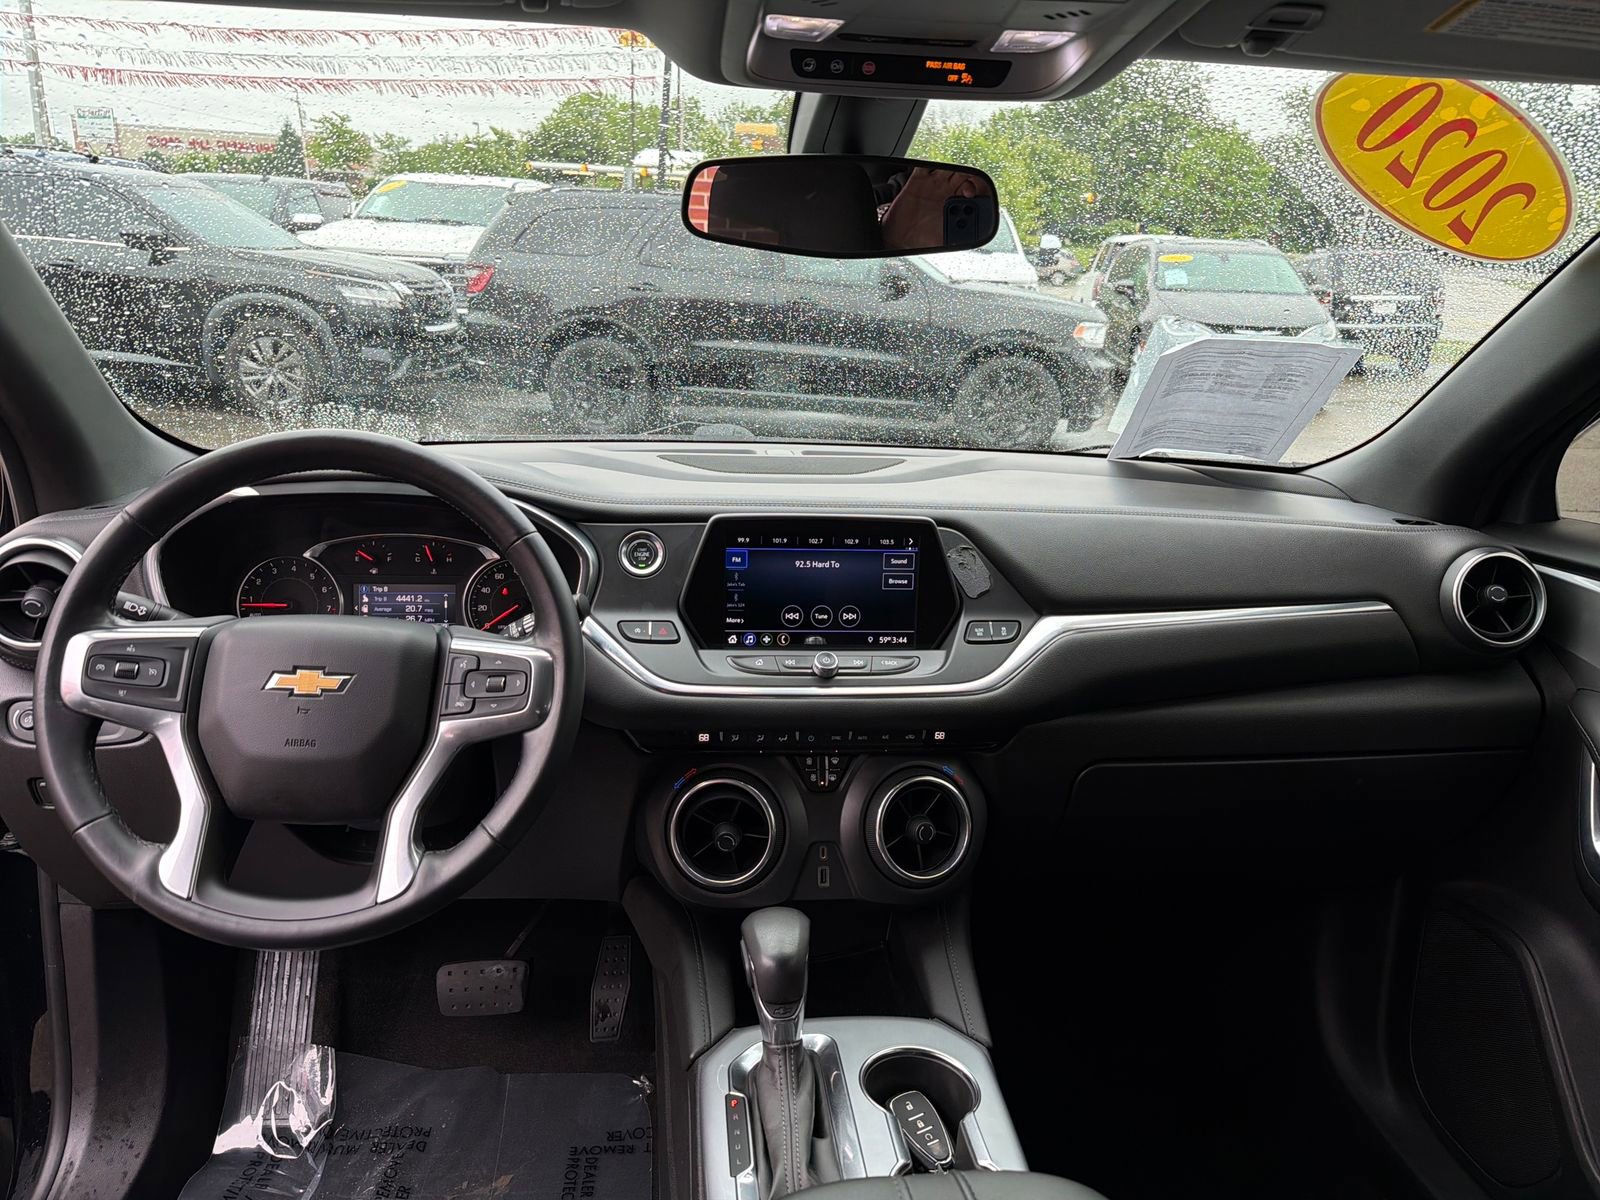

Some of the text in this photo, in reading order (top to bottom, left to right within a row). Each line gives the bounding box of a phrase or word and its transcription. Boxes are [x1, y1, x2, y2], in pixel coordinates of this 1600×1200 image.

[926, 61, 941, 69] PASS
[953, 62, 966, 71] BAG
[947, 74, 959, 82] OFF
[795, 560, 840, 568] 92.5 Hard To
[890, 557, 908, 565] Sound
[494, 572, 505, 580] 60
[888, 578, 908, 586] Browse
[396, 595, 423, 603] 4441.2
[405, 605, 422, 613] 20.7
[726, 616, 741, 624] More
[892, 636, 908, 644] 3:44
[698, 733, 710, 742] 68
[934, 732, 946, 740] 68
[284, 738, 317, 748] AIRBAG
[339, 1125, 433, 1142] PROTECTIVE
[607, 1127, 655, 1142] COVER
[369, 1140, 427, 1154] DEALER
[569, 1144, 634, 1156] REMOVE
[580, 1158, 598, 1198] DEALER
